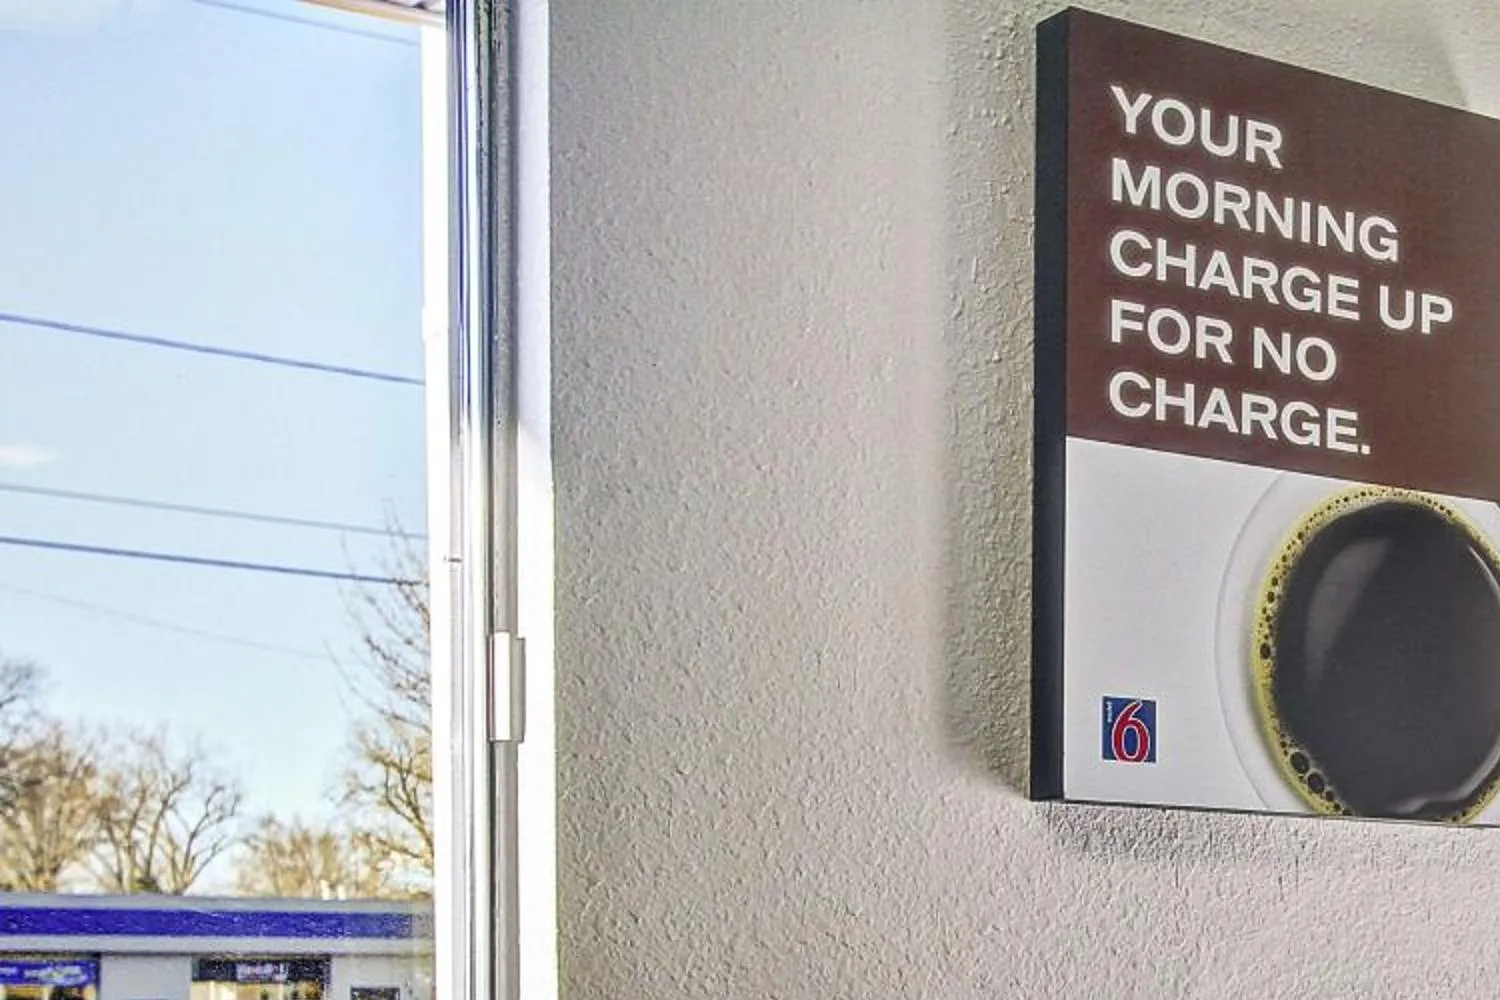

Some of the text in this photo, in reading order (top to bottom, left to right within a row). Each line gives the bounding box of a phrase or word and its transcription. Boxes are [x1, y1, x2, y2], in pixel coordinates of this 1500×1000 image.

[1110, 85, 1283, 169] YOUR
[1111, 157, 1399, 263] MORNING
[1109, 229, 1454, 335] CHARGE UP
[1111, 298, 1337, 381] FOR NO
[1109, 371, 1371, 455] CHARGE.
[1111, 700, 1151, 764] 6
